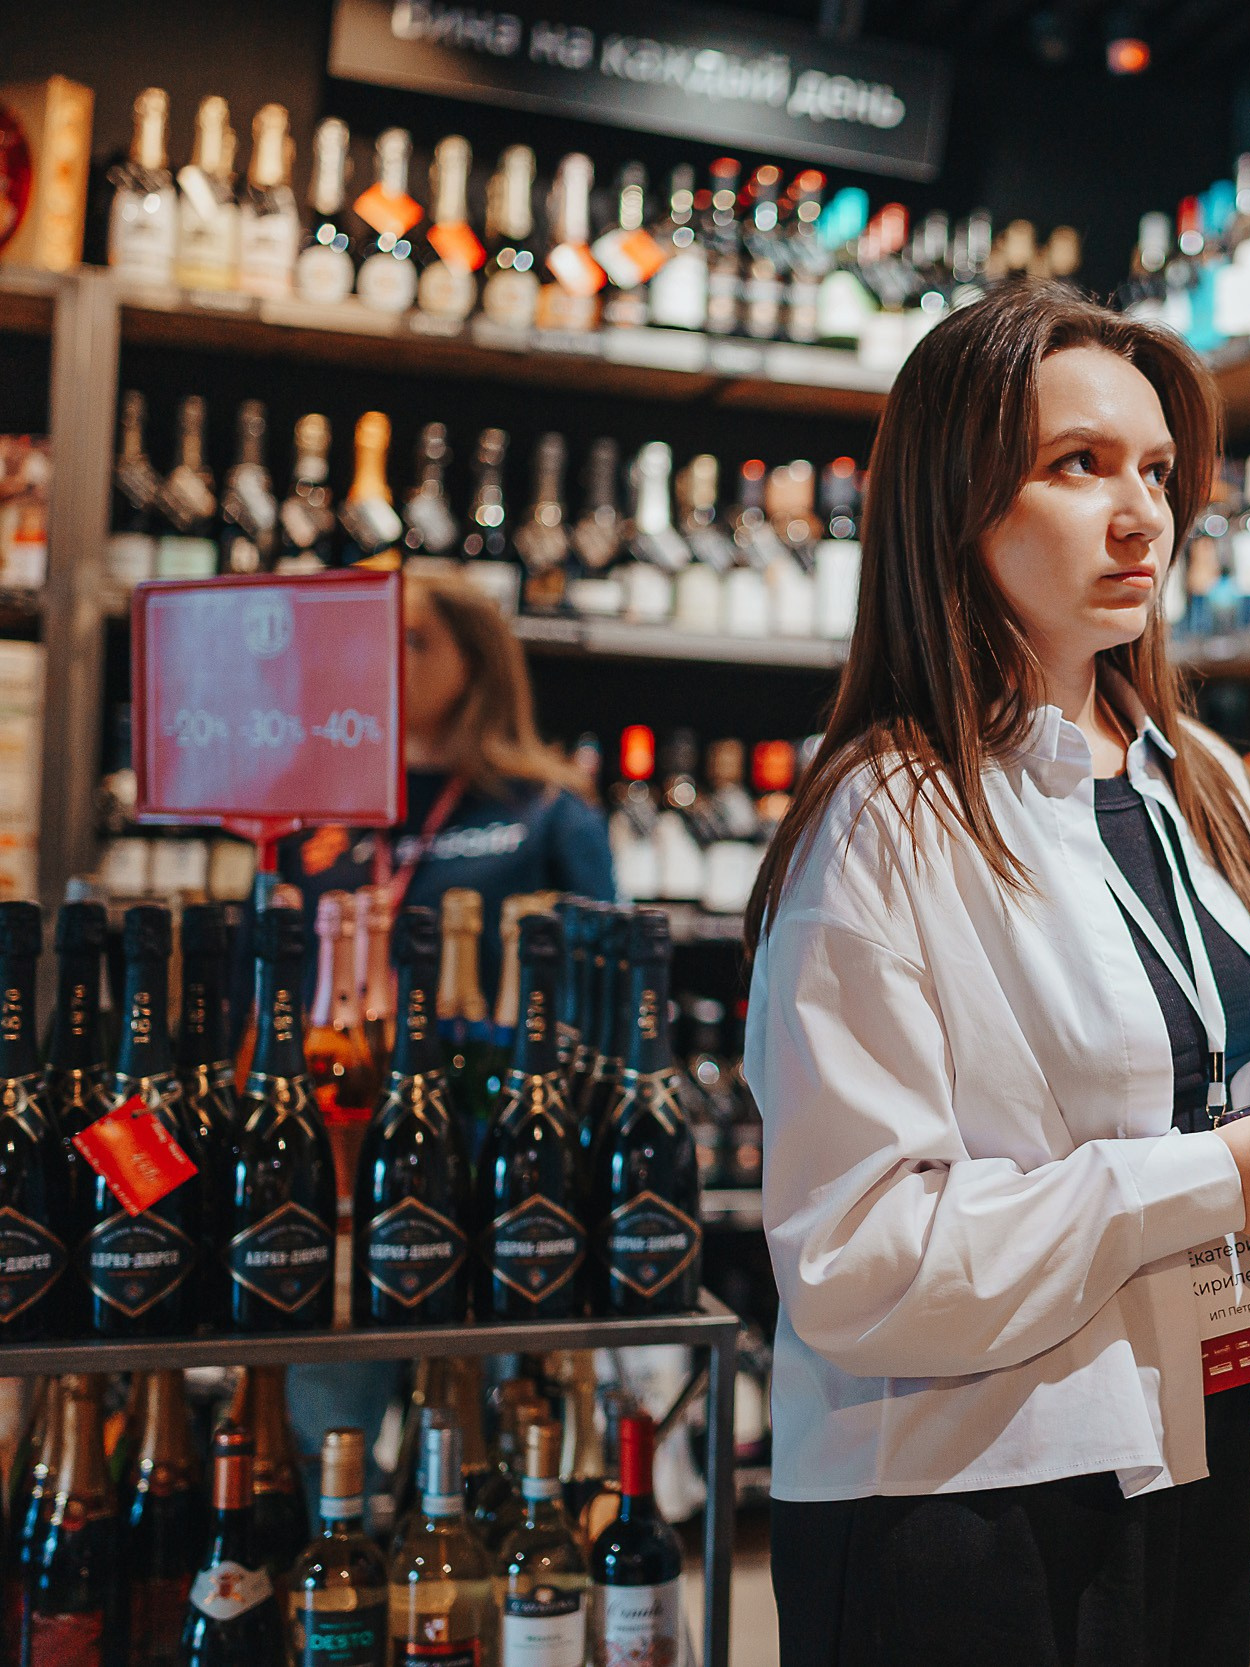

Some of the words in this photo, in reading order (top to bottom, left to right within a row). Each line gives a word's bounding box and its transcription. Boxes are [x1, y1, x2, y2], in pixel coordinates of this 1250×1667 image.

[391, 0, 521, 58] Вина
[529, 24, 594, 70] на
[601, 37, 788, 106] каждый
[787, 69, 906, 131] день
[312, 708, 382, 748] -40%
[1, 988, 21, 1041] 1870
[131, 991, 151, 1045] 1870
[1209, 1309, 1227, 1322] ИП
